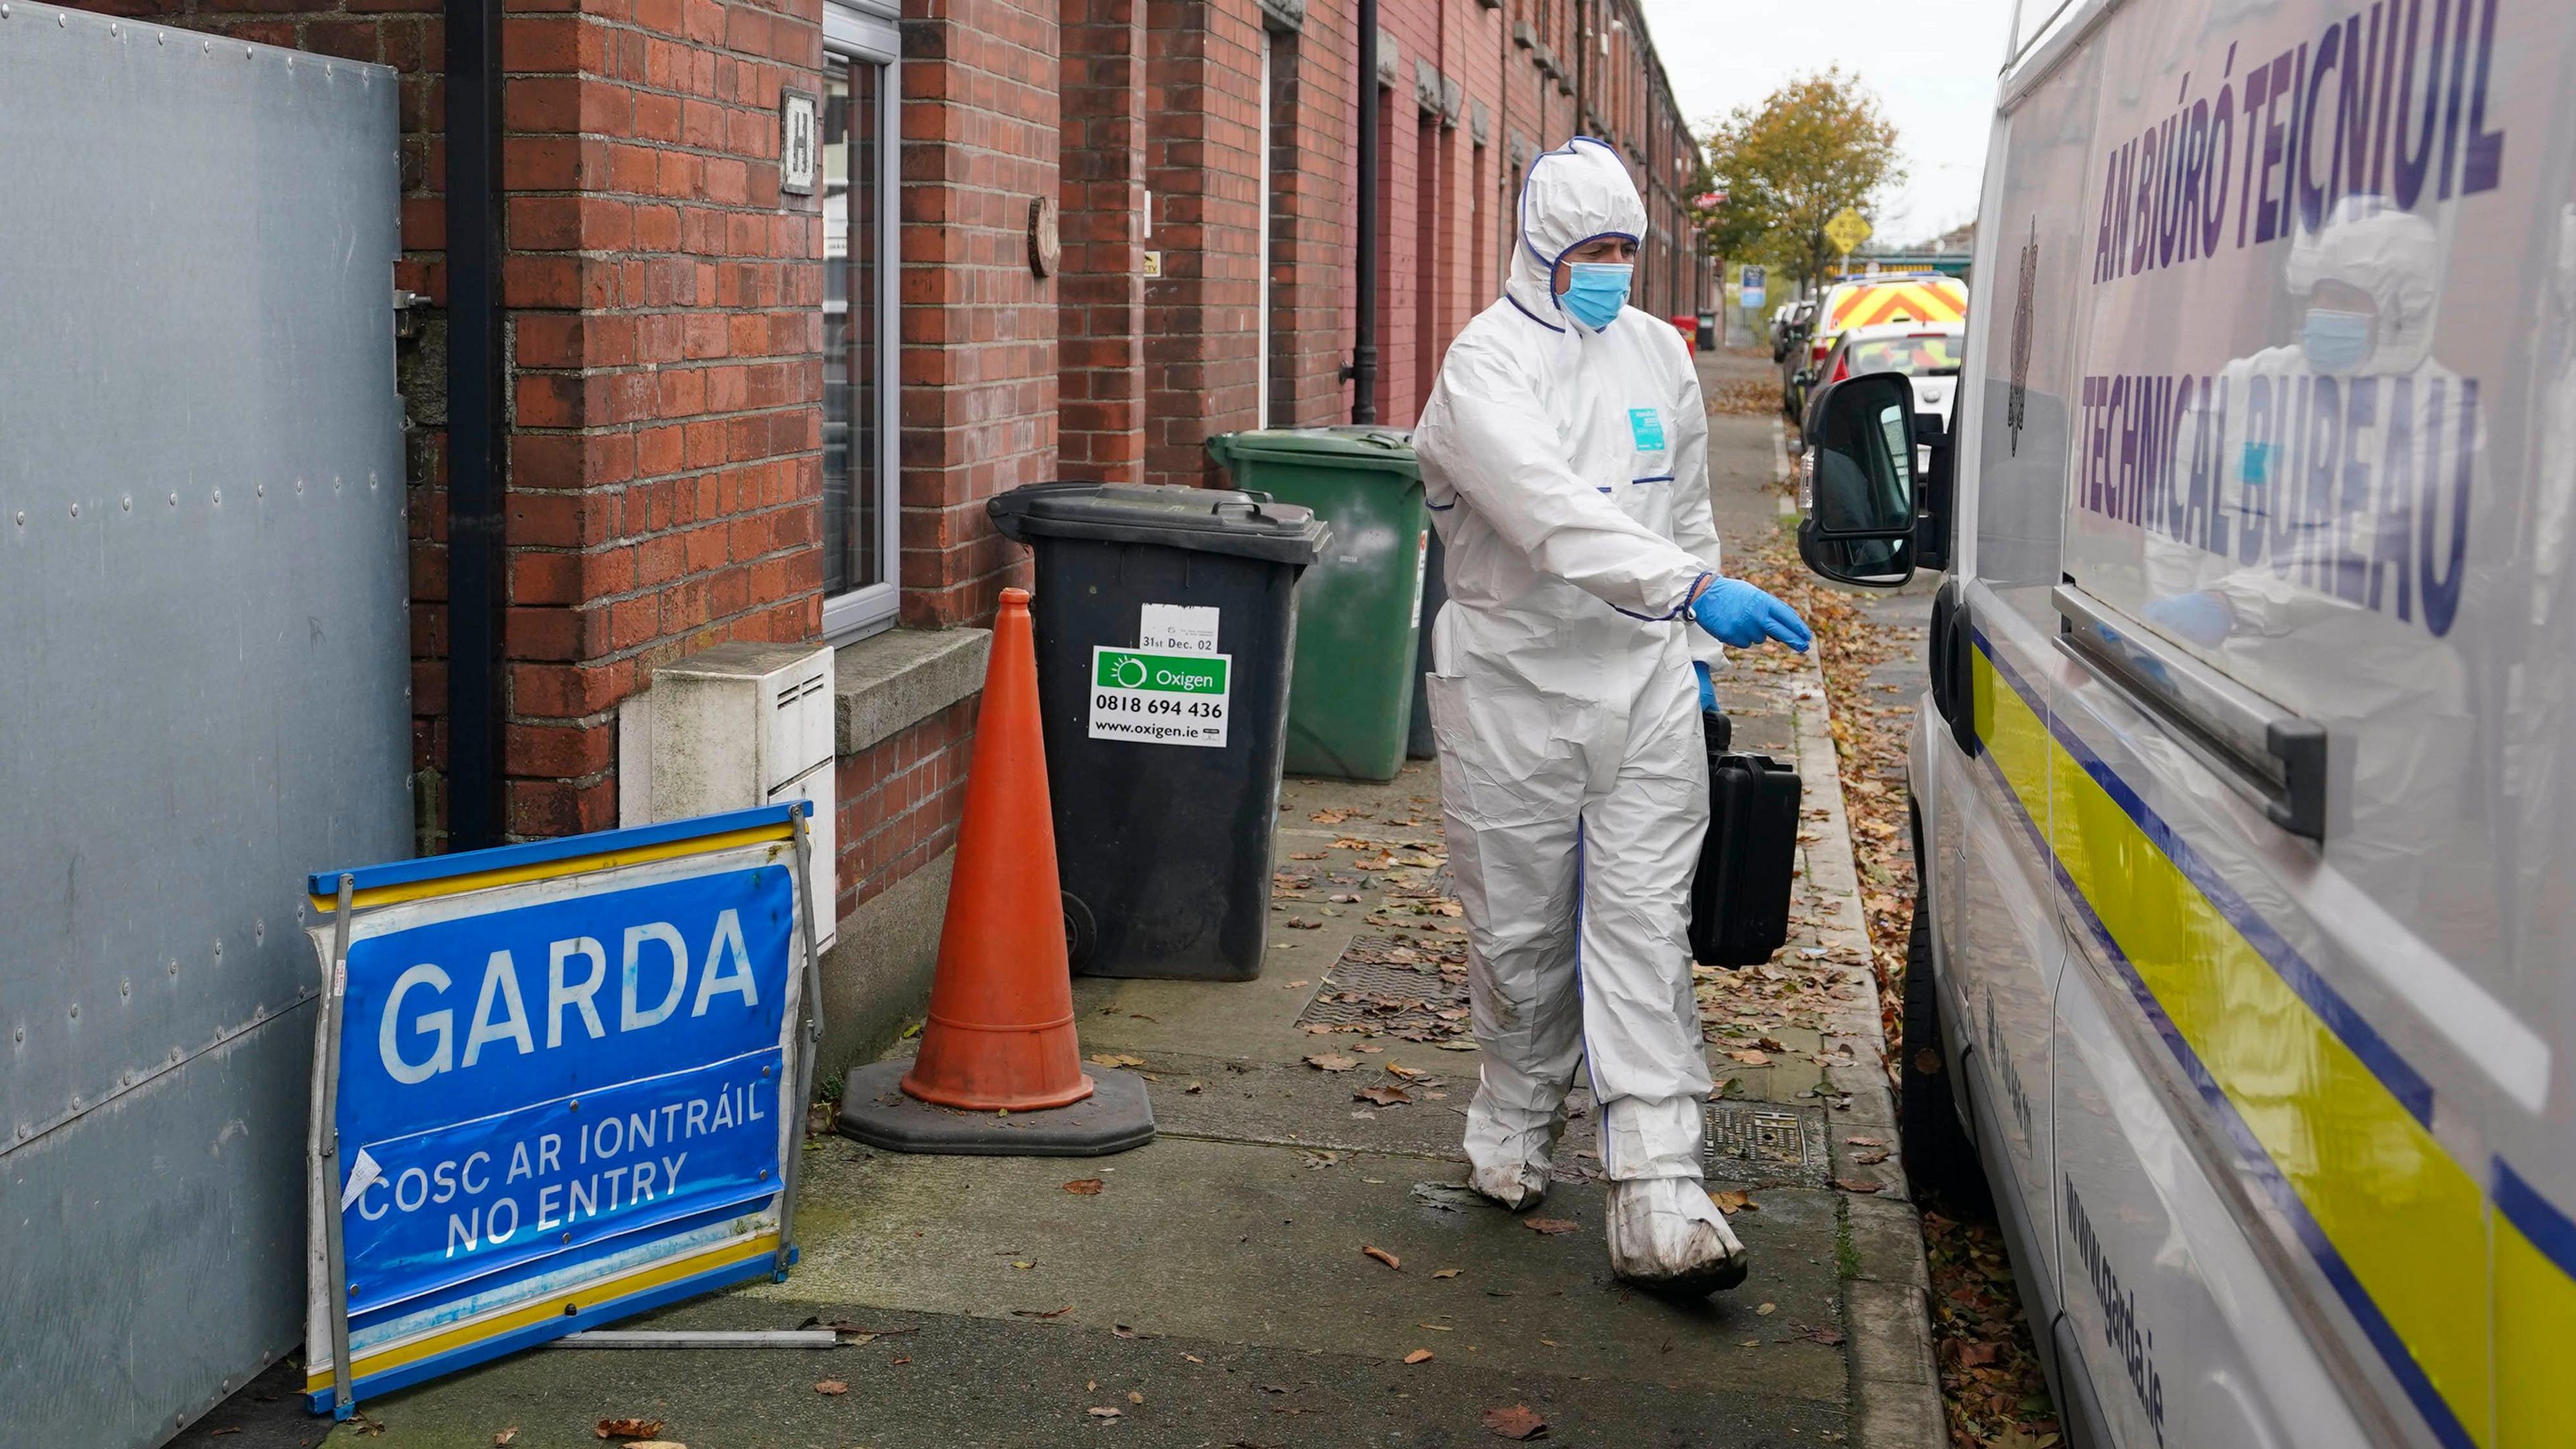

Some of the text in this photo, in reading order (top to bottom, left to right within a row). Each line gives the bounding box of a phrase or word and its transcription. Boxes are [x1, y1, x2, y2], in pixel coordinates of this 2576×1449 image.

[2092, 136, 2138, 284] AN
[2131, 40, 2238, 276] BIÚRÓ
[2080, 373, 2479, 638] TECHNICAL BUREAU
[1096, 694, 1222, 718] 0818 694 436
[1142, 637, 1212, 651] 31st Dec. 02
[1156, 669, 1213, 691] Oxigen
[1095, 720, 1199, 739] www.oxigen.ie
[378, 908, 760, 1085] GARDA
[358, 1080, 765, 1221] COSC AR IONTRÁIL
[445, 1151, 688, 1258] NO ENTRY
[2065, 1171, 2165, 1449] www.garda.ie
